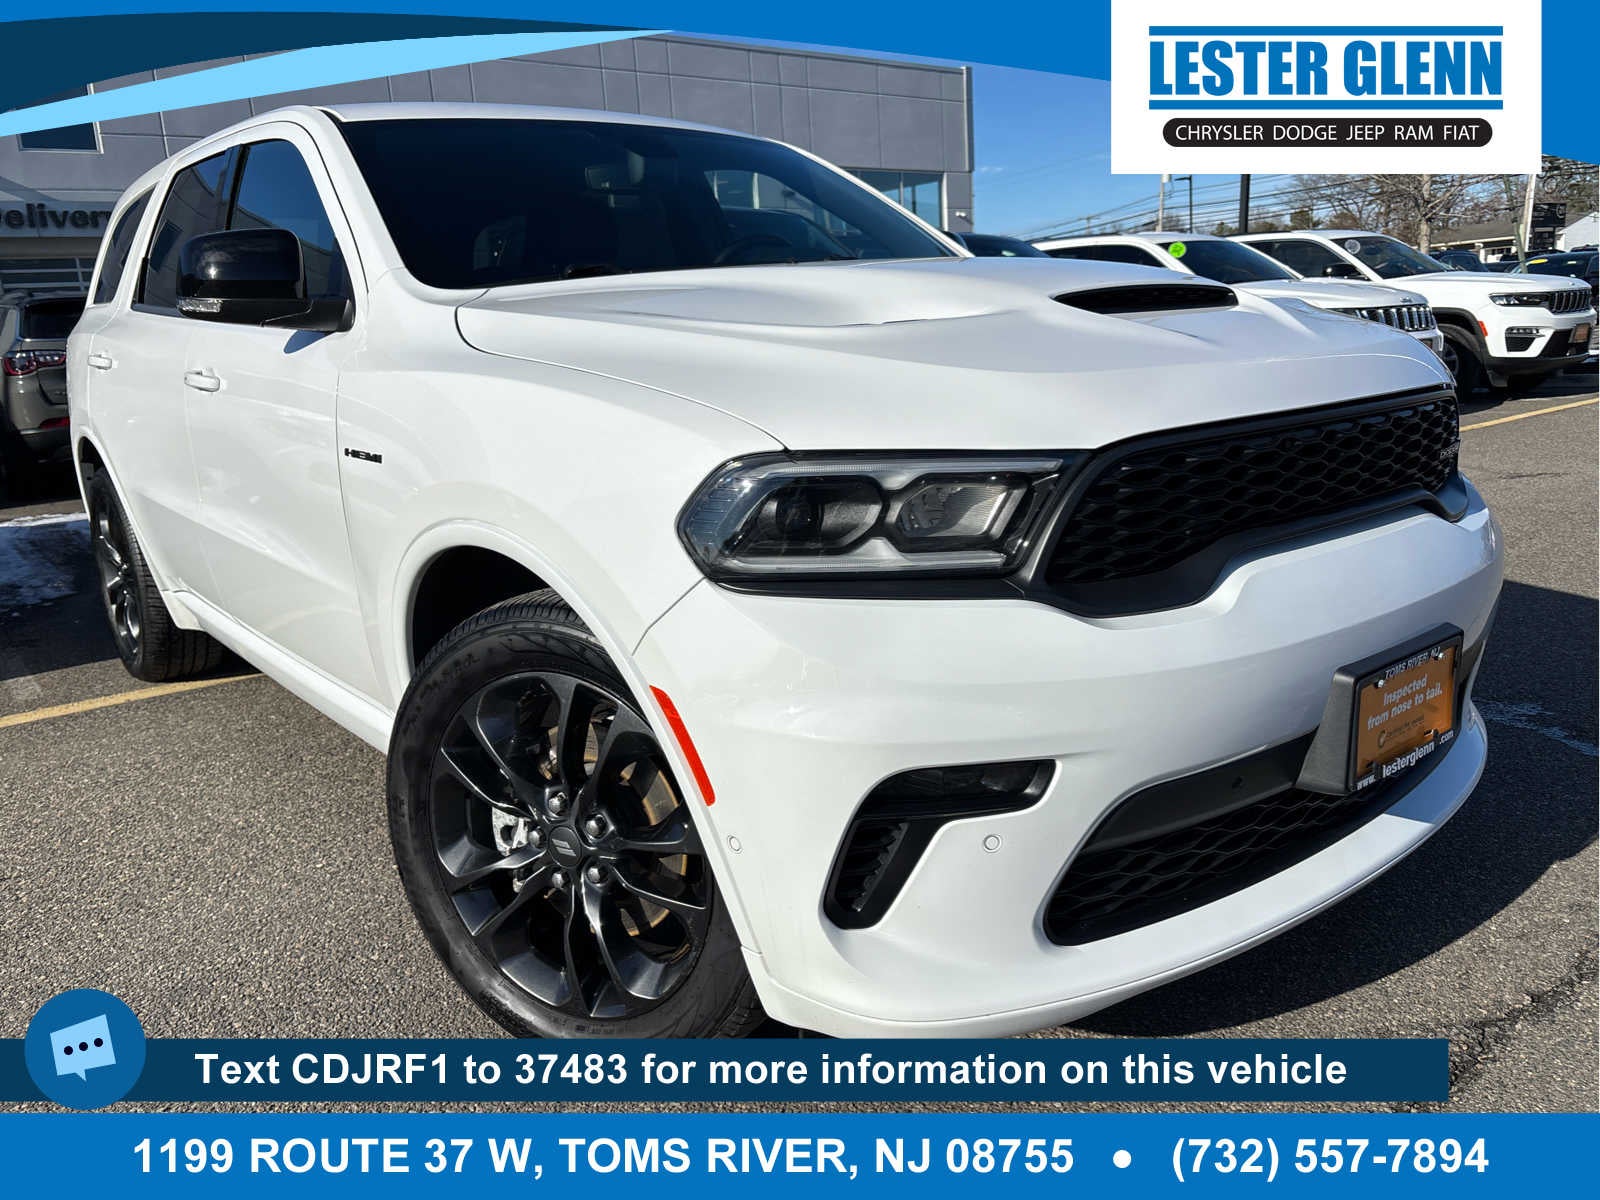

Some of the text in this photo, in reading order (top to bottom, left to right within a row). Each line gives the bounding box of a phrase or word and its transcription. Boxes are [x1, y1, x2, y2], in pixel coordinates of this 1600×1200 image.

[0, 203, 111, 229] eliver
[1386, 662, 1407, 679] TOMS
[1384, 674, 1428, 706] Inspected
[1367, 711, 1389, 731] from
[1391, 699, 1413, 718] nose
[1414, 693, 1424, 706] to
[1357, 774, 1377, 790] www.
[1382, 741, 1435, 778] lesterglenn
